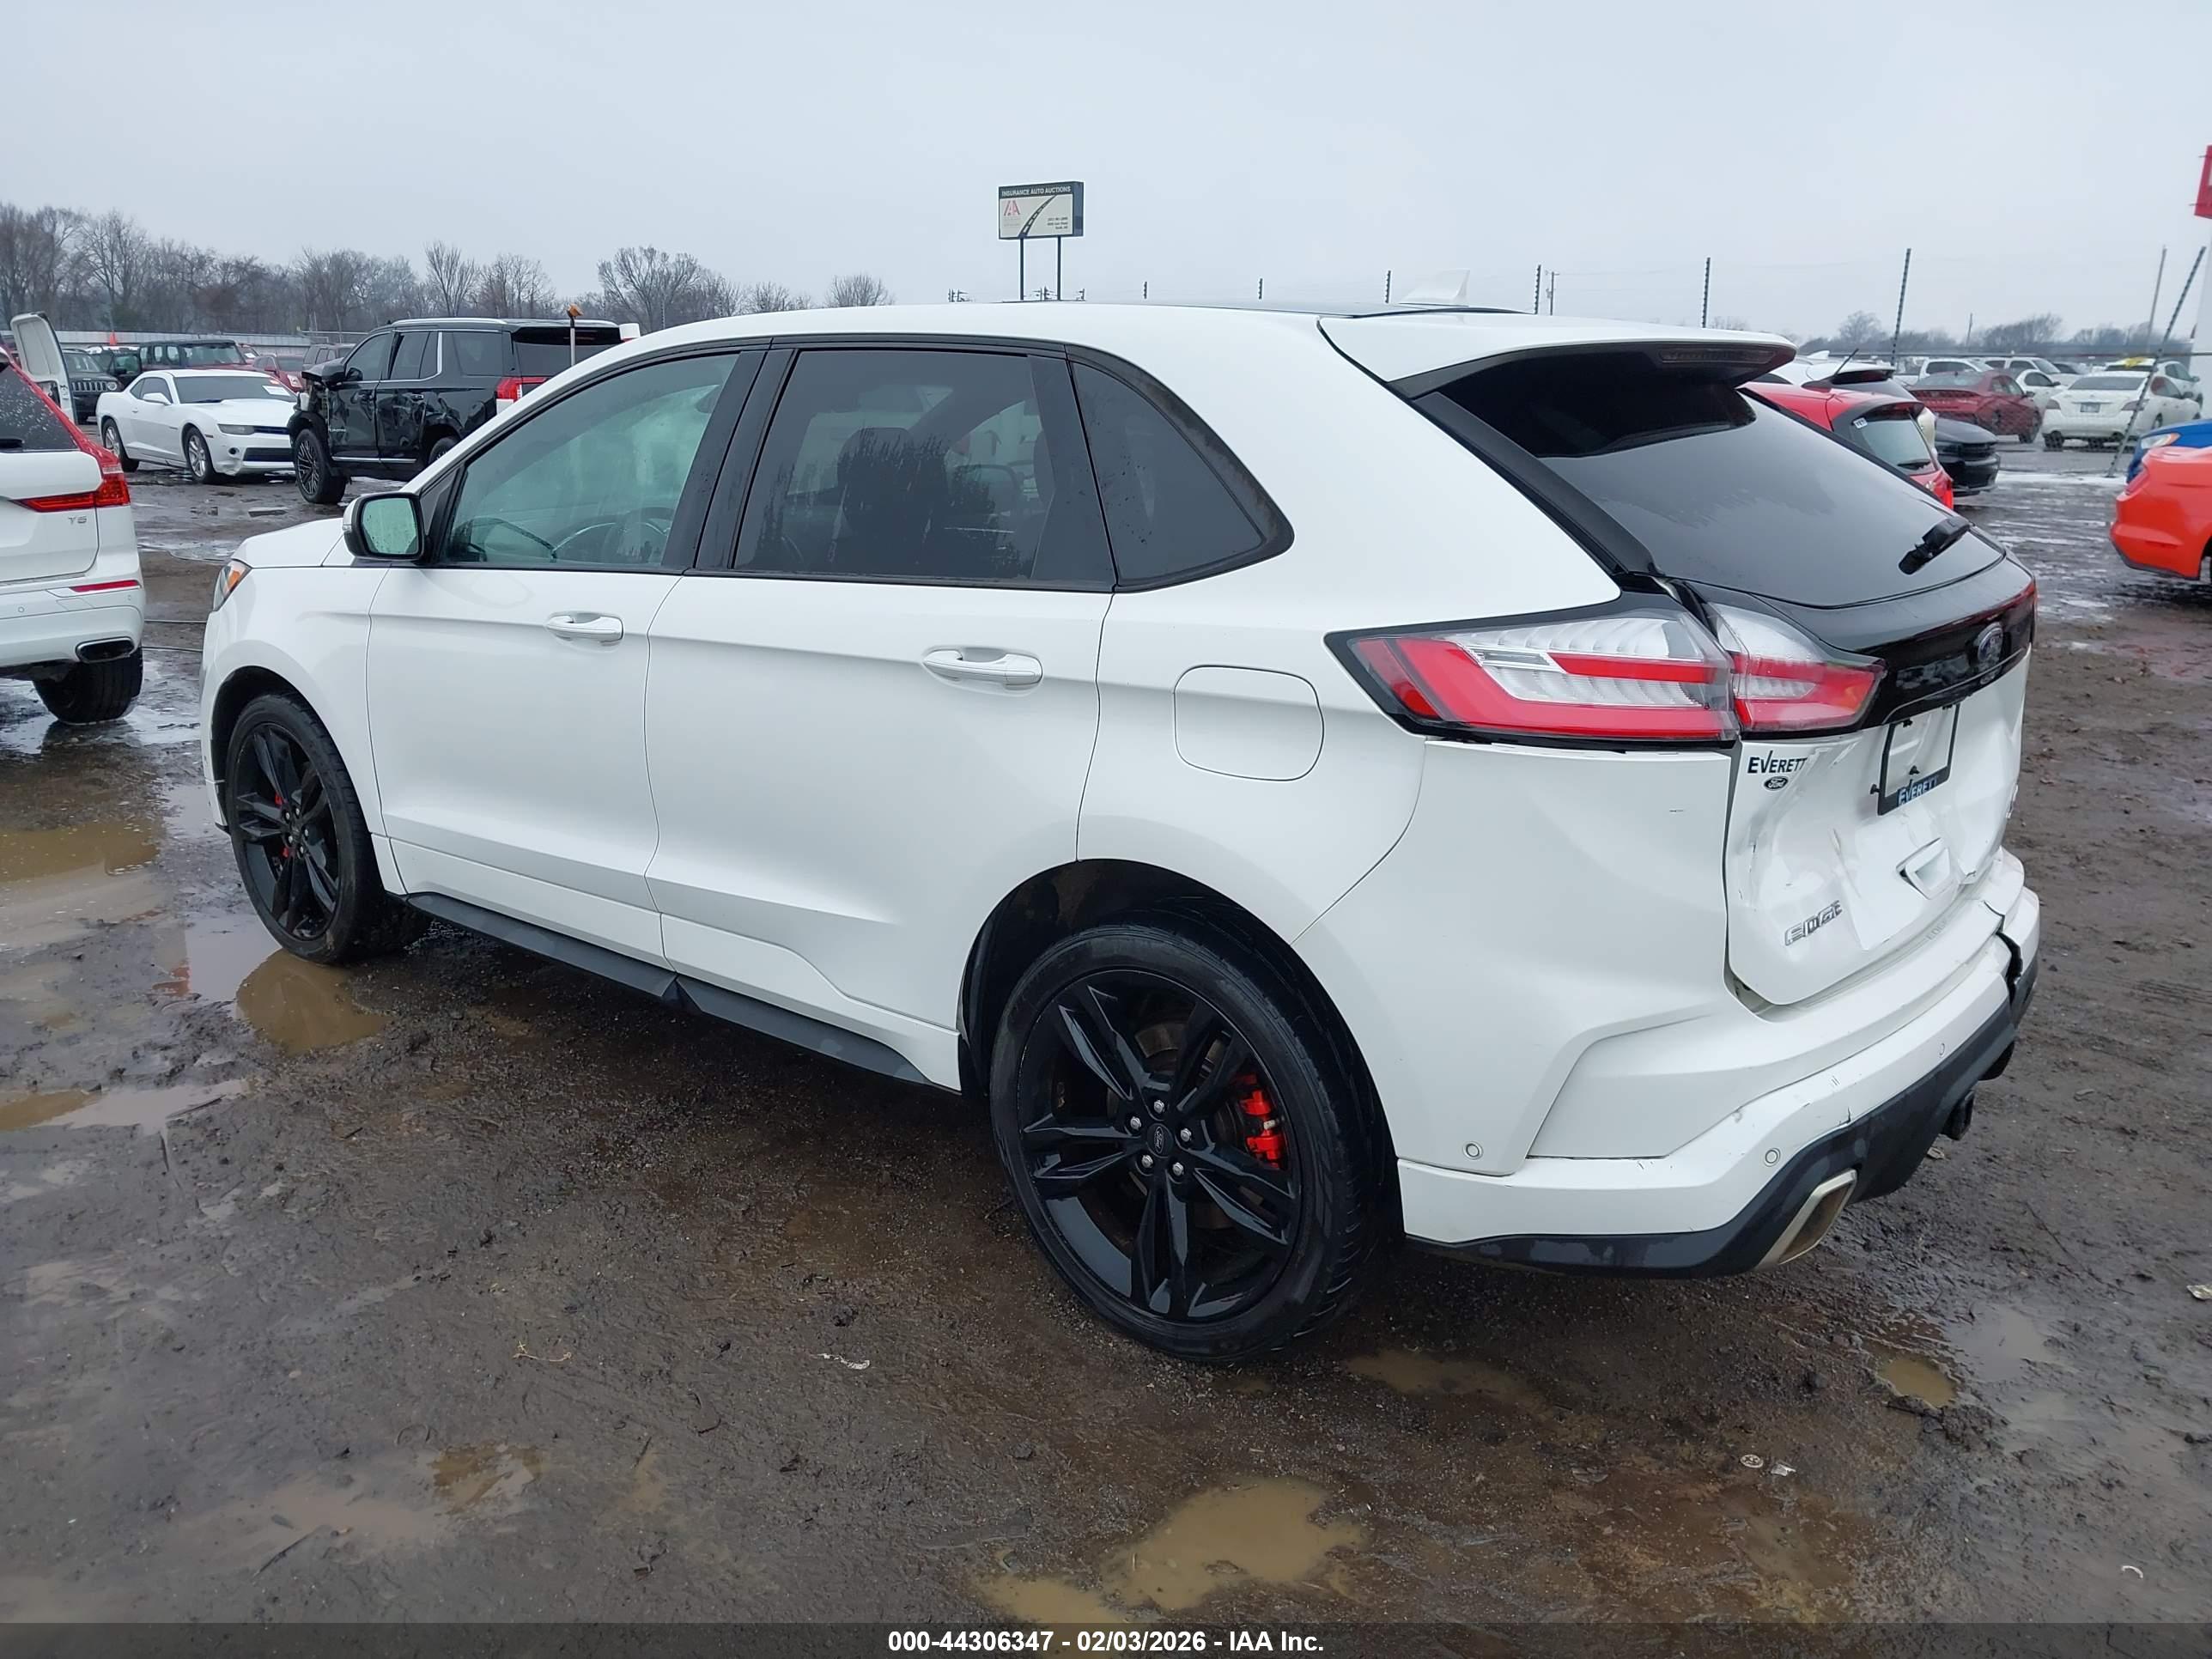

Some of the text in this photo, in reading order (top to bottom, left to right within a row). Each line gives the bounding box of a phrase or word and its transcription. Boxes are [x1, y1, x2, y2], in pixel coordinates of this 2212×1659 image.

[1001, 189, 1030, 198] INSURANCE
[1045, 185, 1071, 194] AUCTIONS
[1747, 750, 1808, 774] EVERETT
[1898, 776, 1938, 805] EVERETT
[1784, 900, 1843, 946] EDGE
